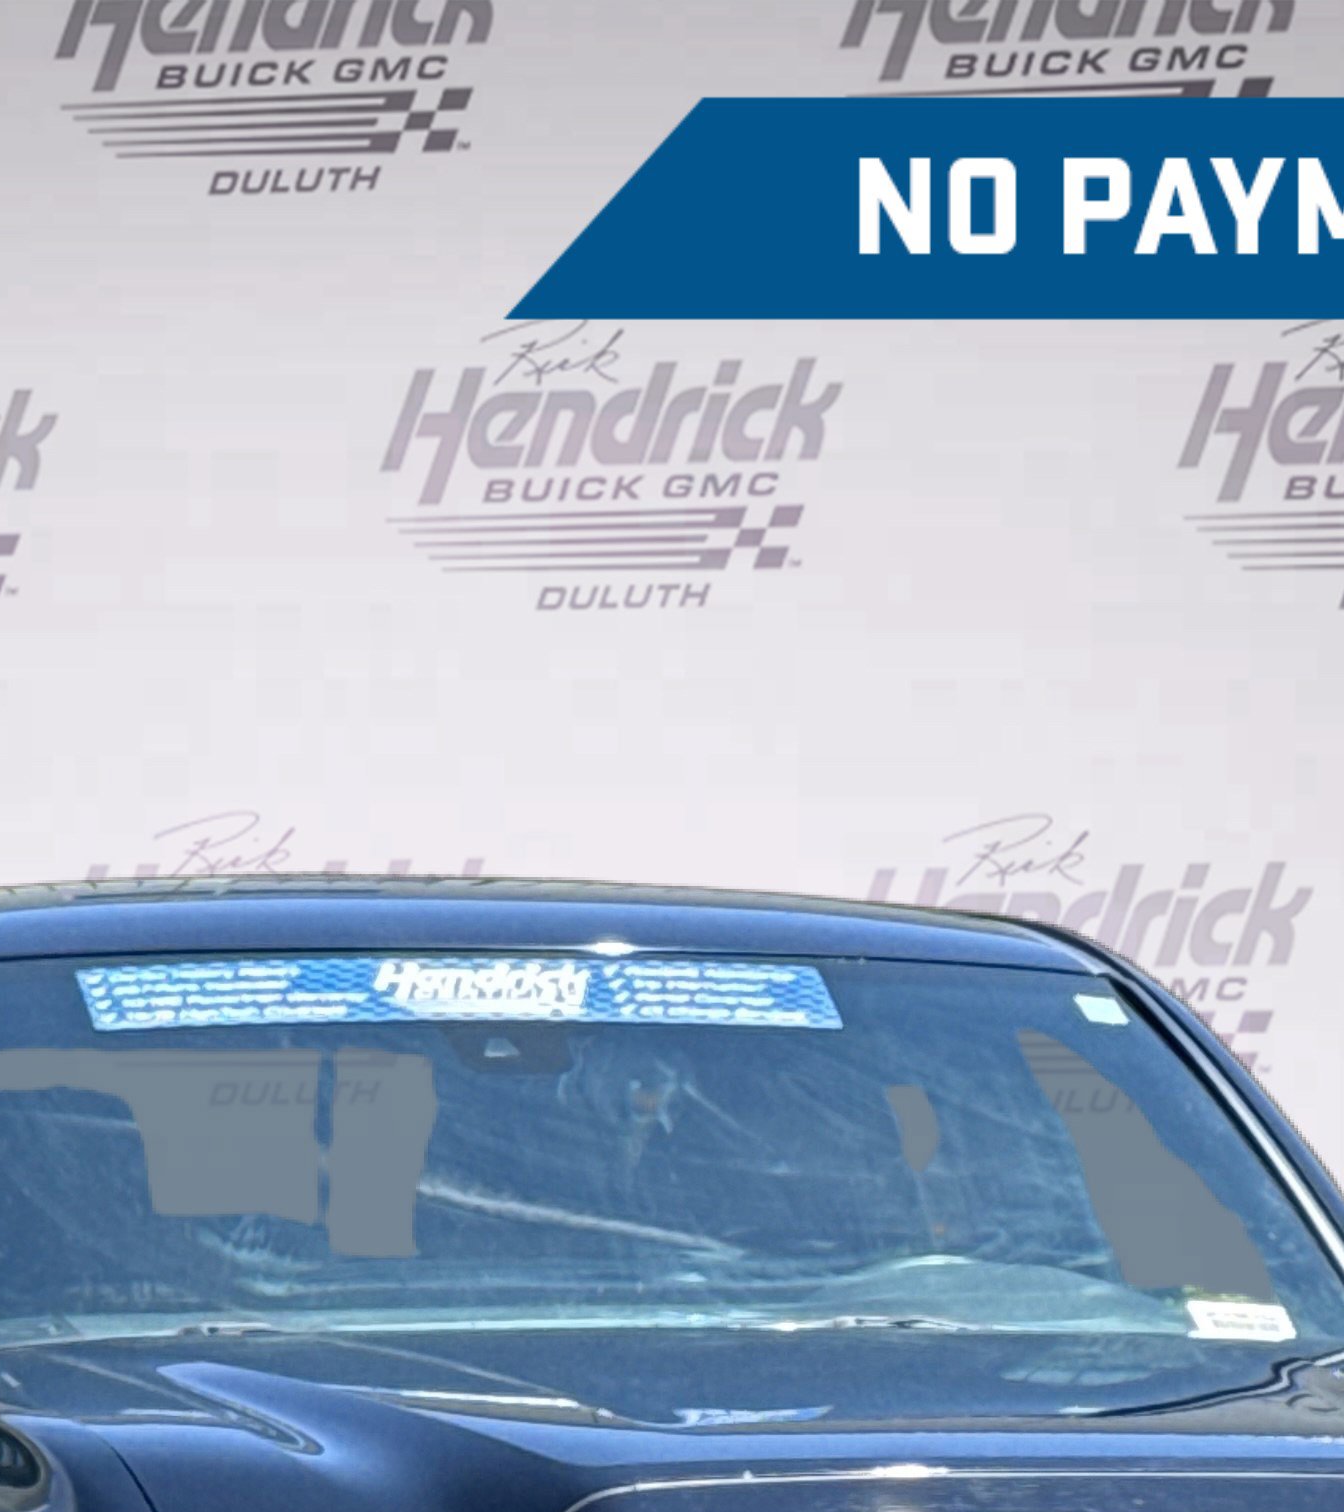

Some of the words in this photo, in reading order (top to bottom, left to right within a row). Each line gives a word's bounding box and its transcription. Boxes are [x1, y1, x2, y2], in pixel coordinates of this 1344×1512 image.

[156, 59, 316, 90] BUICK
[333, 55, 449, 84] GMC
[945, 48, 1111, 79] BUICK
[1128, 44, 1248, 72] GMC
[208, 165, 382, 196] DULUTH
[379, 357, 844, 506] Hendrick
[482, 475, 644, 503] BUICK
[662, 472, 780, 499] GMC
[535, 582, 711, 611] DULUTH
